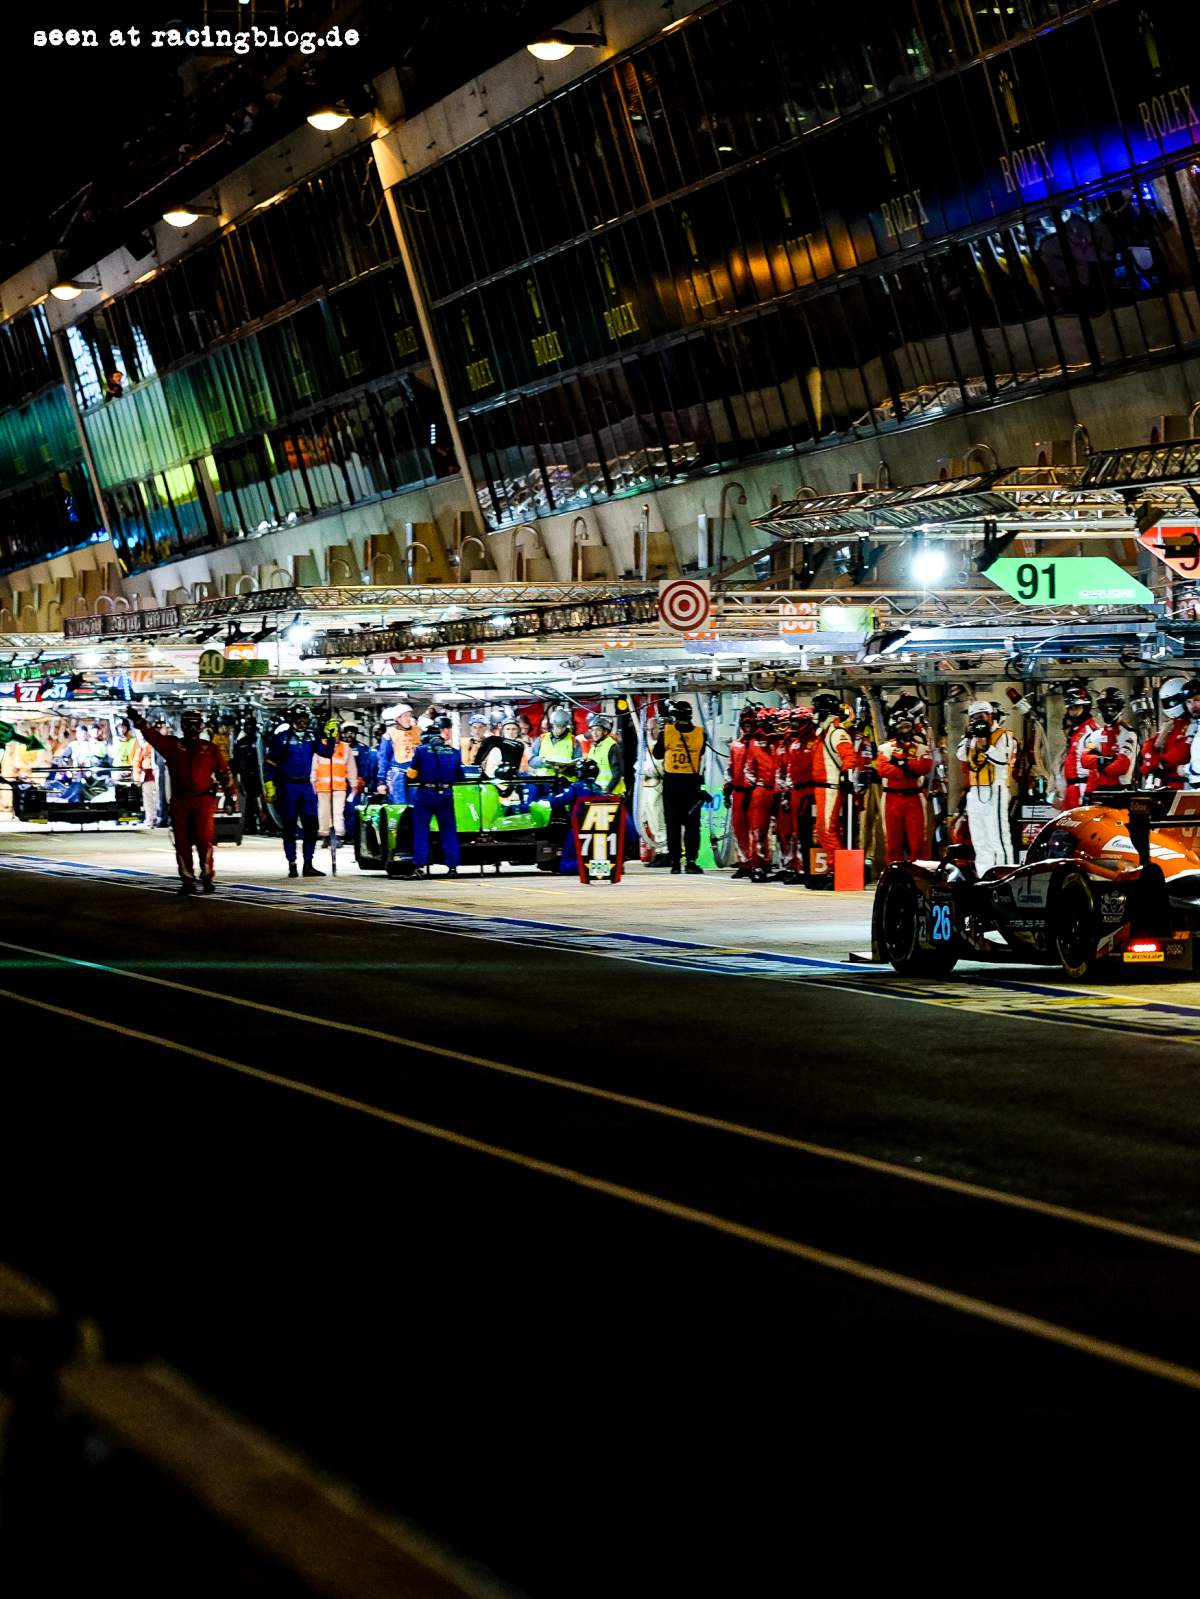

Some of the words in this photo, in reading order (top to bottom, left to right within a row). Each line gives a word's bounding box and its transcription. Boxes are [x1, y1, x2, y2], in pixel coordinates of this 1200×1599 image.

[1138, 85, 1200, 141] ROLEX
[999, 141, 1054, 193] ROLEX
[881, 190, 930, 237] ROLEX
[1016, 563, 1056, 600] 91
[200, 654, 225, 674] 40
[20, 687, 39, 702] 27
[932, 904, 951, 941] 26
